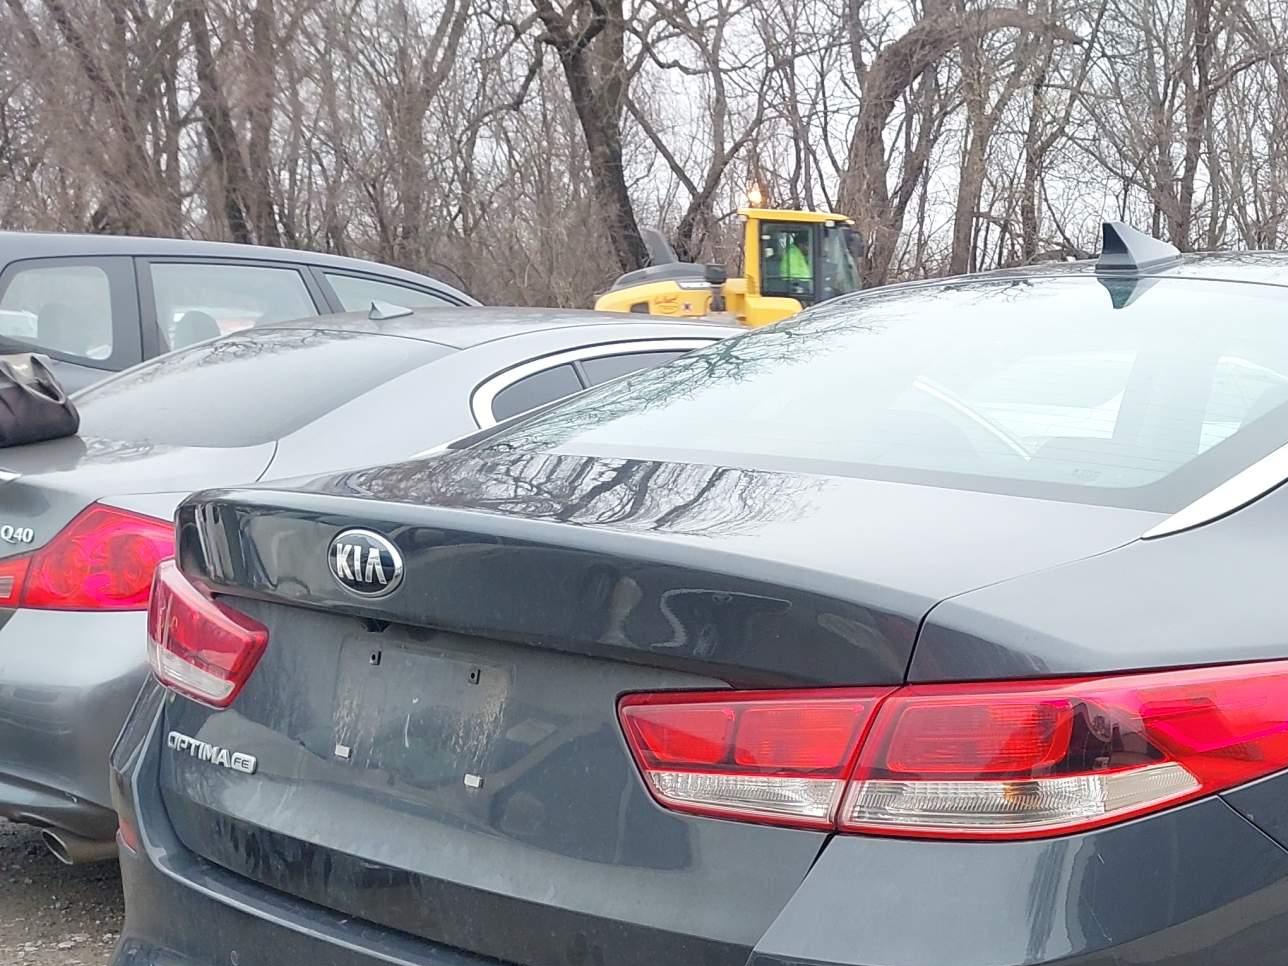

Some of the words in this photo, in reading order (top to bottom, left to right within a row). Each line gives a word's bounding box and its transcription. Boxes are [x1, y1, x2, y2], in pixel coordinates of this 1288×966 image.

[1, 525, 34, 544] Q40
[336, 543, 388, 584] KIA
[168, 731, 231, 768] OPTIMA
